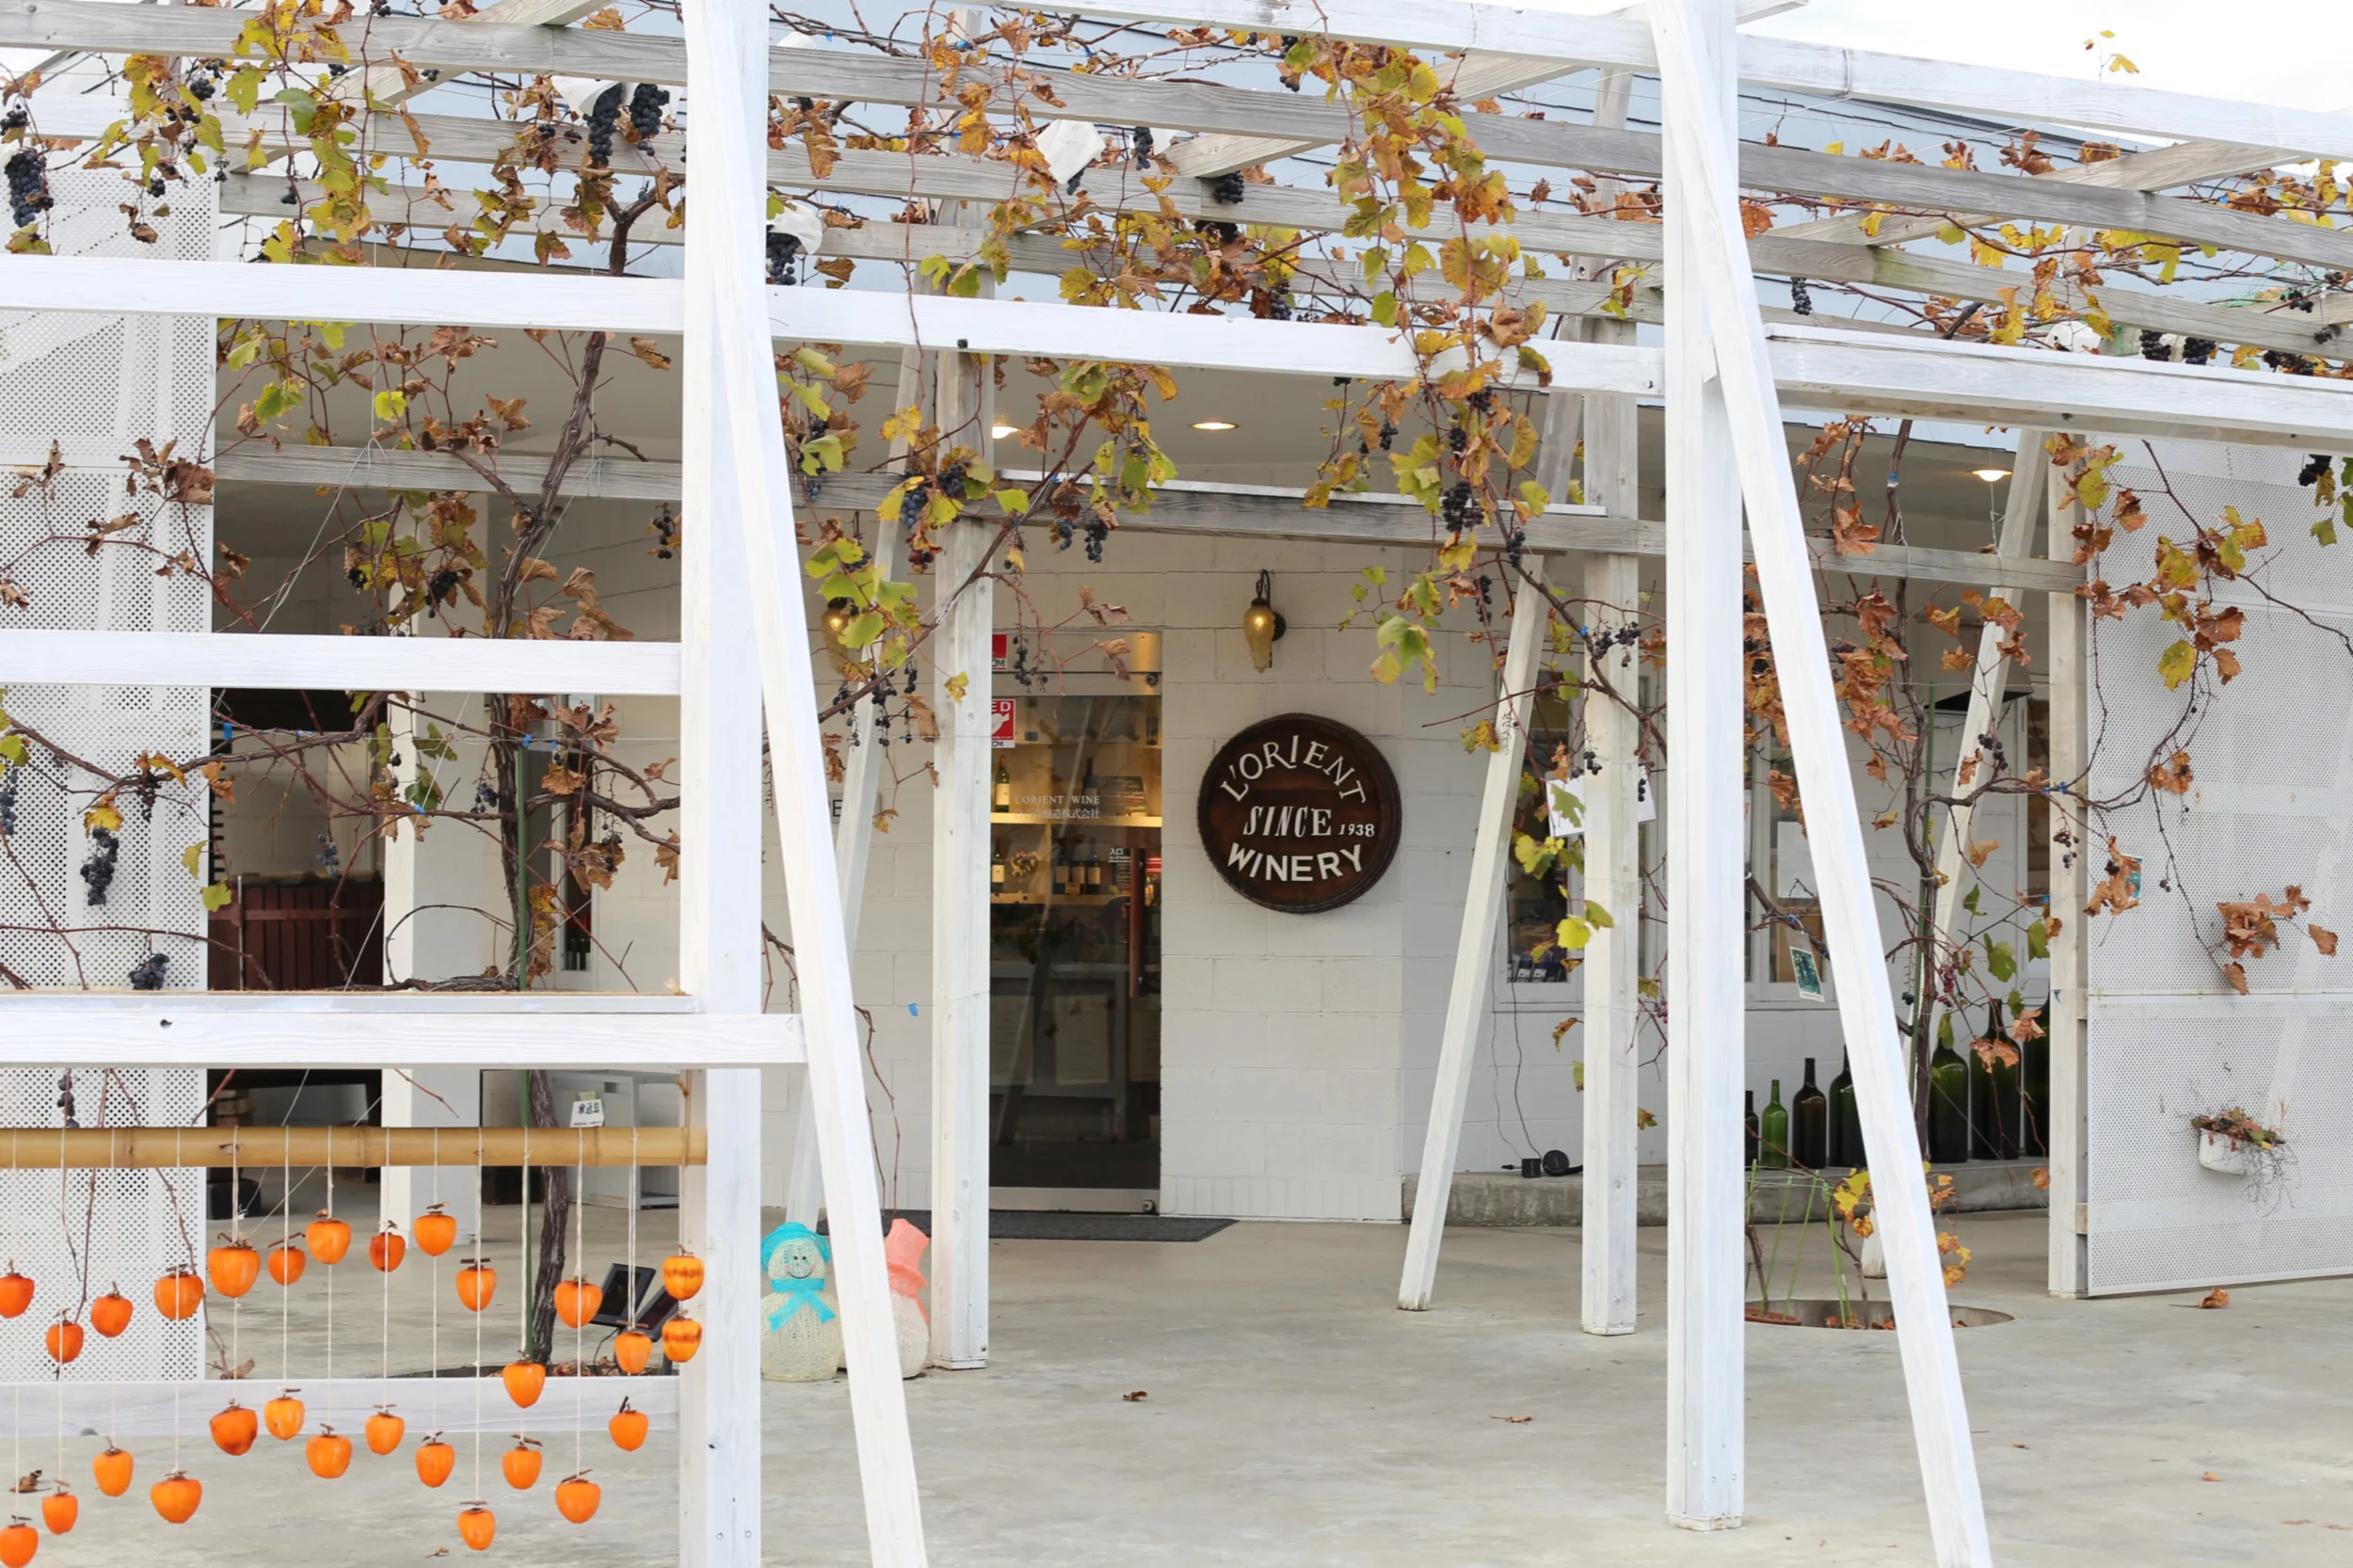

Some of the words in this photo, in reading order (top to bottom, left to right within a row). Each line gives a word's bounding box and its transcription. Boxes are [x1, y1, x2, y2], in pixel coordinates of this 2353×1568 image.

[1220, 734, 1366, 803] L'ORIENT
[1071, 795, 1100, 804] WINE
[1242, 806, 1331, 838] SINCE
[1338, 824, 1375, 838] 1938
[1227, 842, 1364, 881] WINERY
